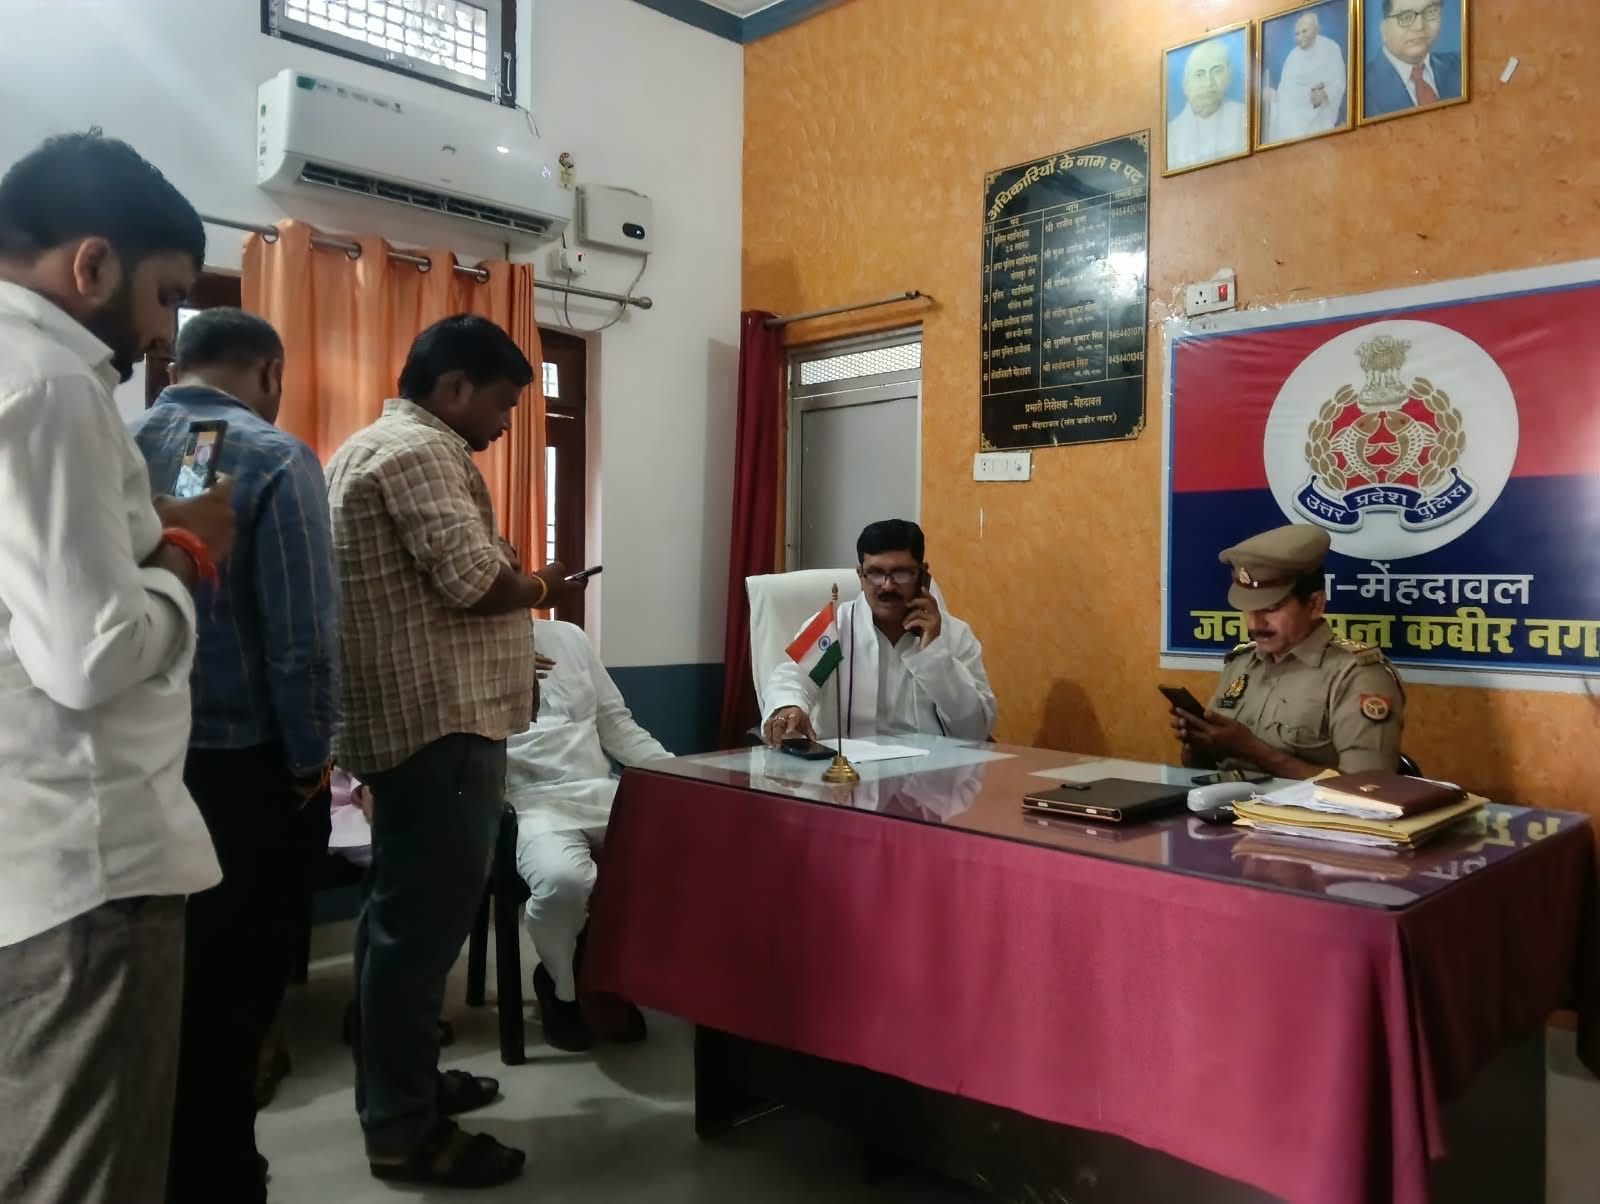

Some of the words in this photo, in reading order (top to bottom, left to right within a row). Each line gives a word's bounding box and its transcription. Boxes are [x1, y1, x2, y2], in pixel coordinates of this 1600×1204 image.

[987, 157, 1057, 221] अधिकारियों
[1059, 154, 1075, 170] के
[1076, 154, 1107, 169] नाम
[1109, 158, 1123, 172] व
[1123, 163, 1144, 184] पद
[1025, 398, 1041, 414] प्रभारी
[1306, 493, 1347, 522] उत्तर
[1354, 488, 1408, 507] प्रदेश
[1415, 484, 1468, 523] पुलिस
[1190, 610, 1250, 642] जन
[1402, 606, 1517, 654] कबीर
[1525, 618, 1600, 658] नग
